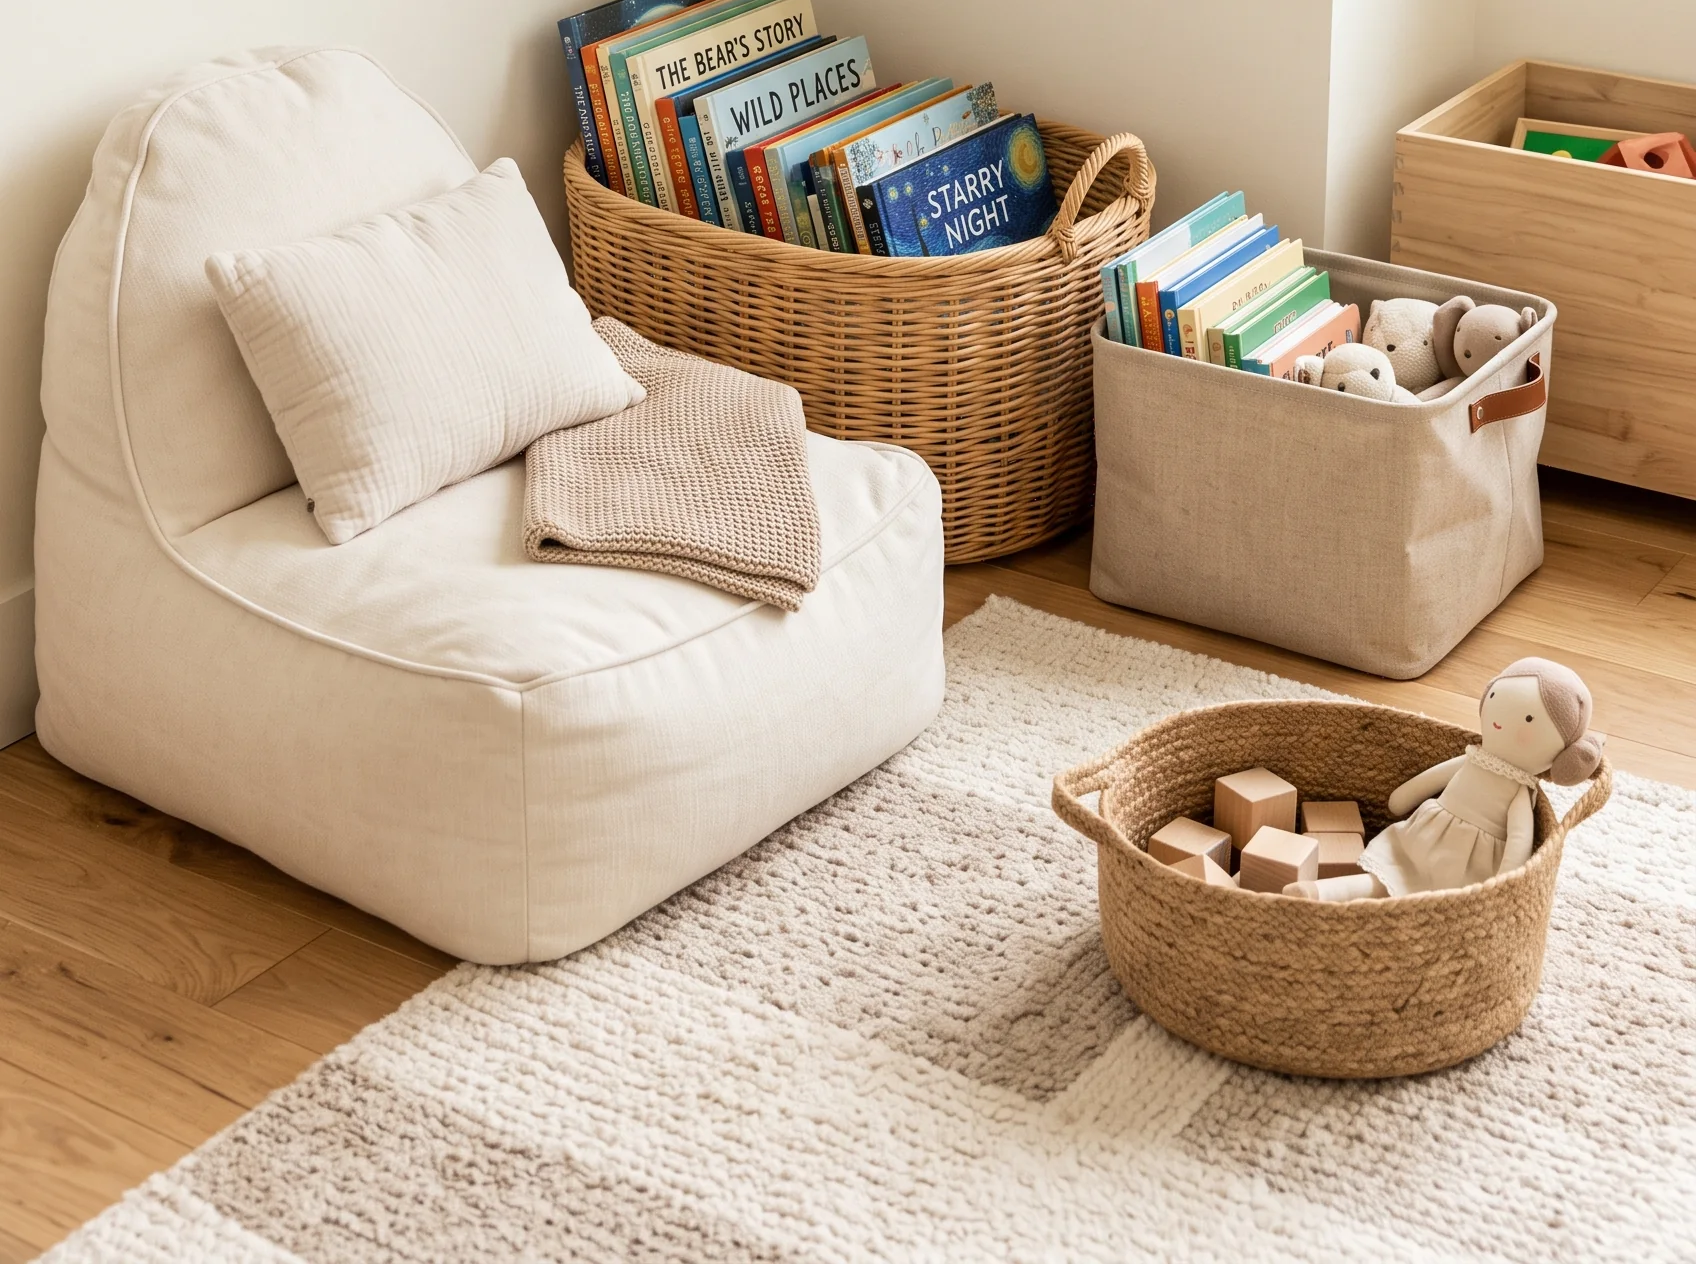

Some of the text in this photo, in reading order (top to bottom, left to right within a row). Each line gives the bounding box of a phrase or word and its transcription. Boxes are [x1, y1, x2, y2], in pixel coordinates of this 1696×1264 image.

[655, 57, 690, 90] THE
[693, 34, 750, 76] BEAR'S
[754, 13, 804, 52] STORY
[729, 58, 861, 136] WILD PLACES
[927, 159, 1004, 219] STARRY
[944, 194, 1010, 249] NIGHT
